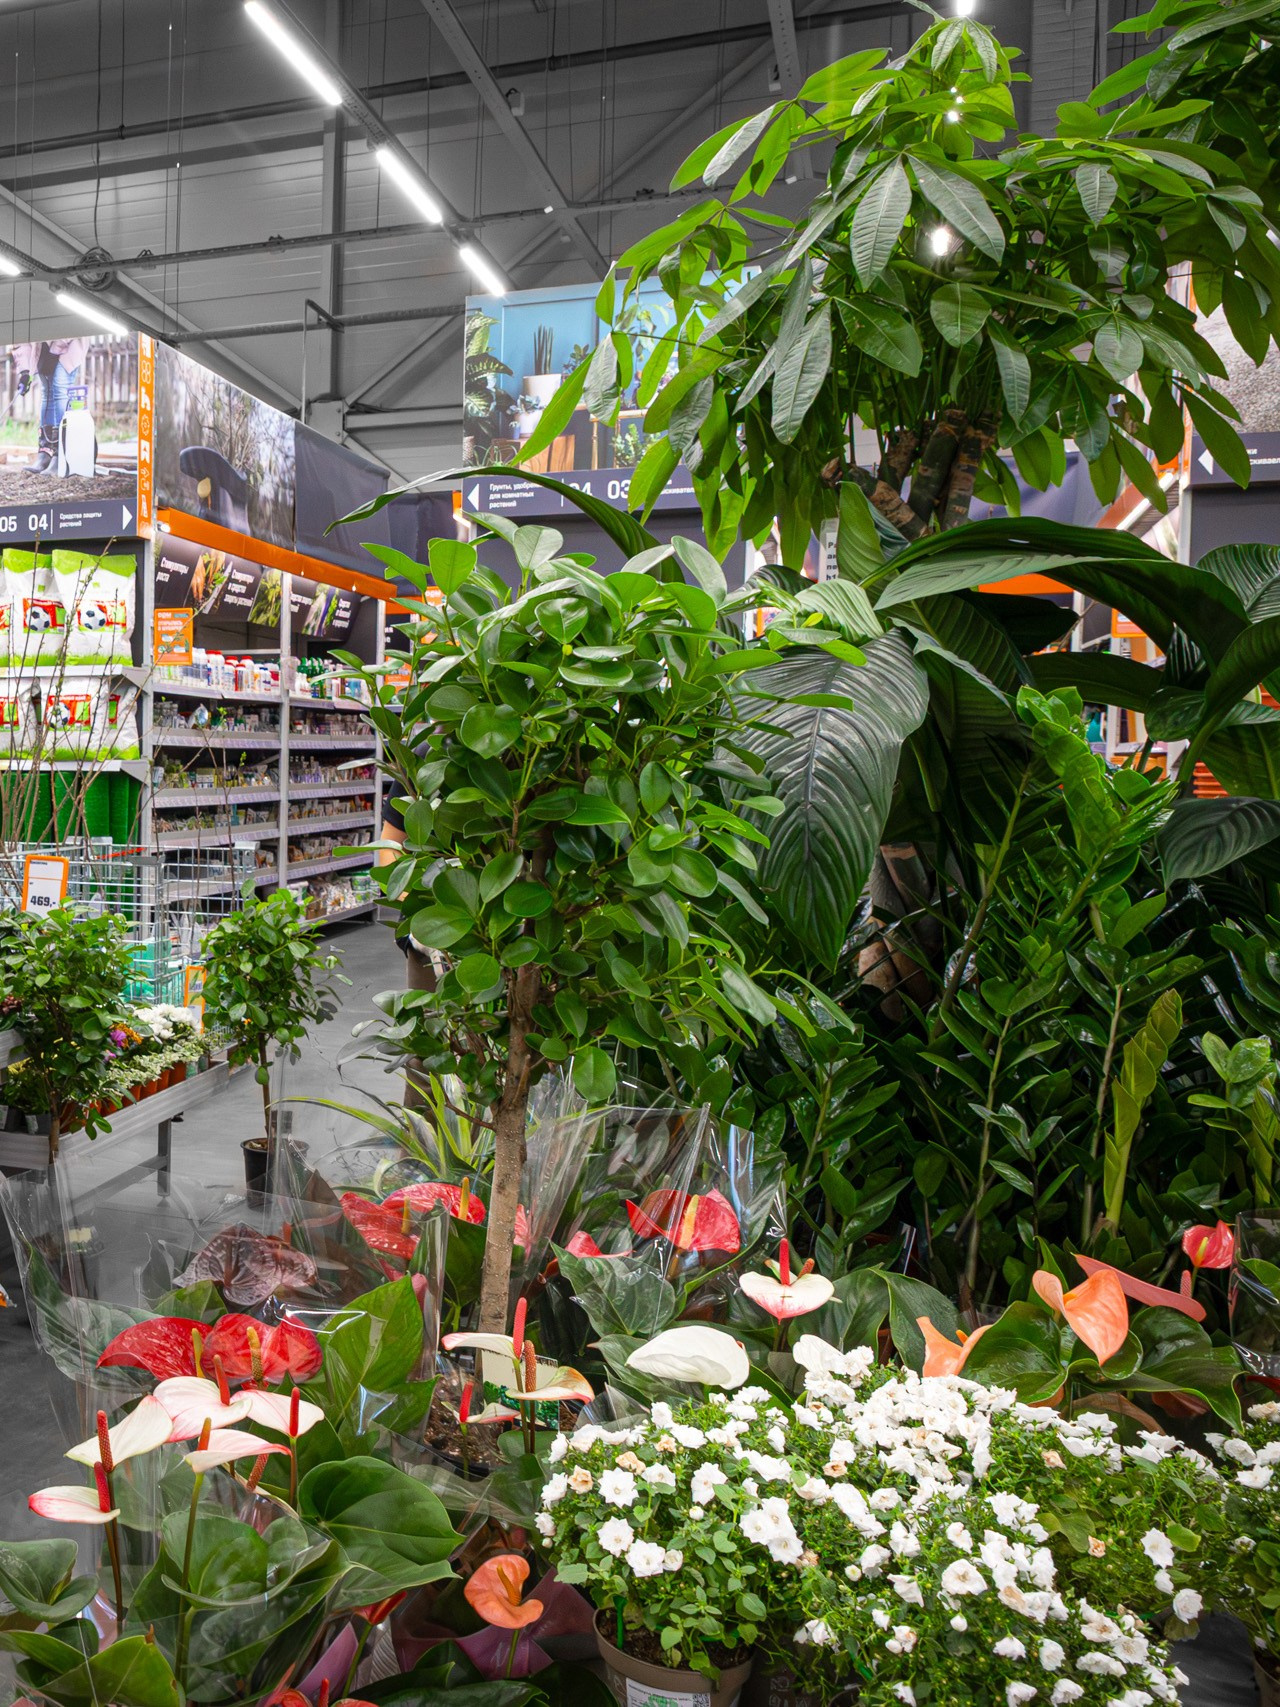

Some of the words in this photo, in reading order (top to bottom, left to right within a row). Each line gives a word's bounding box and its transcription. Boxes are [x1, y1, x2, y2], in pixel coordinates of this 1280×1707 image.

[501, 491, 535, 499] комнатных
[607, 480, 631, 499] 03
[489, 500, 517, 508] растений
[28, 514, 49, 531] 04
